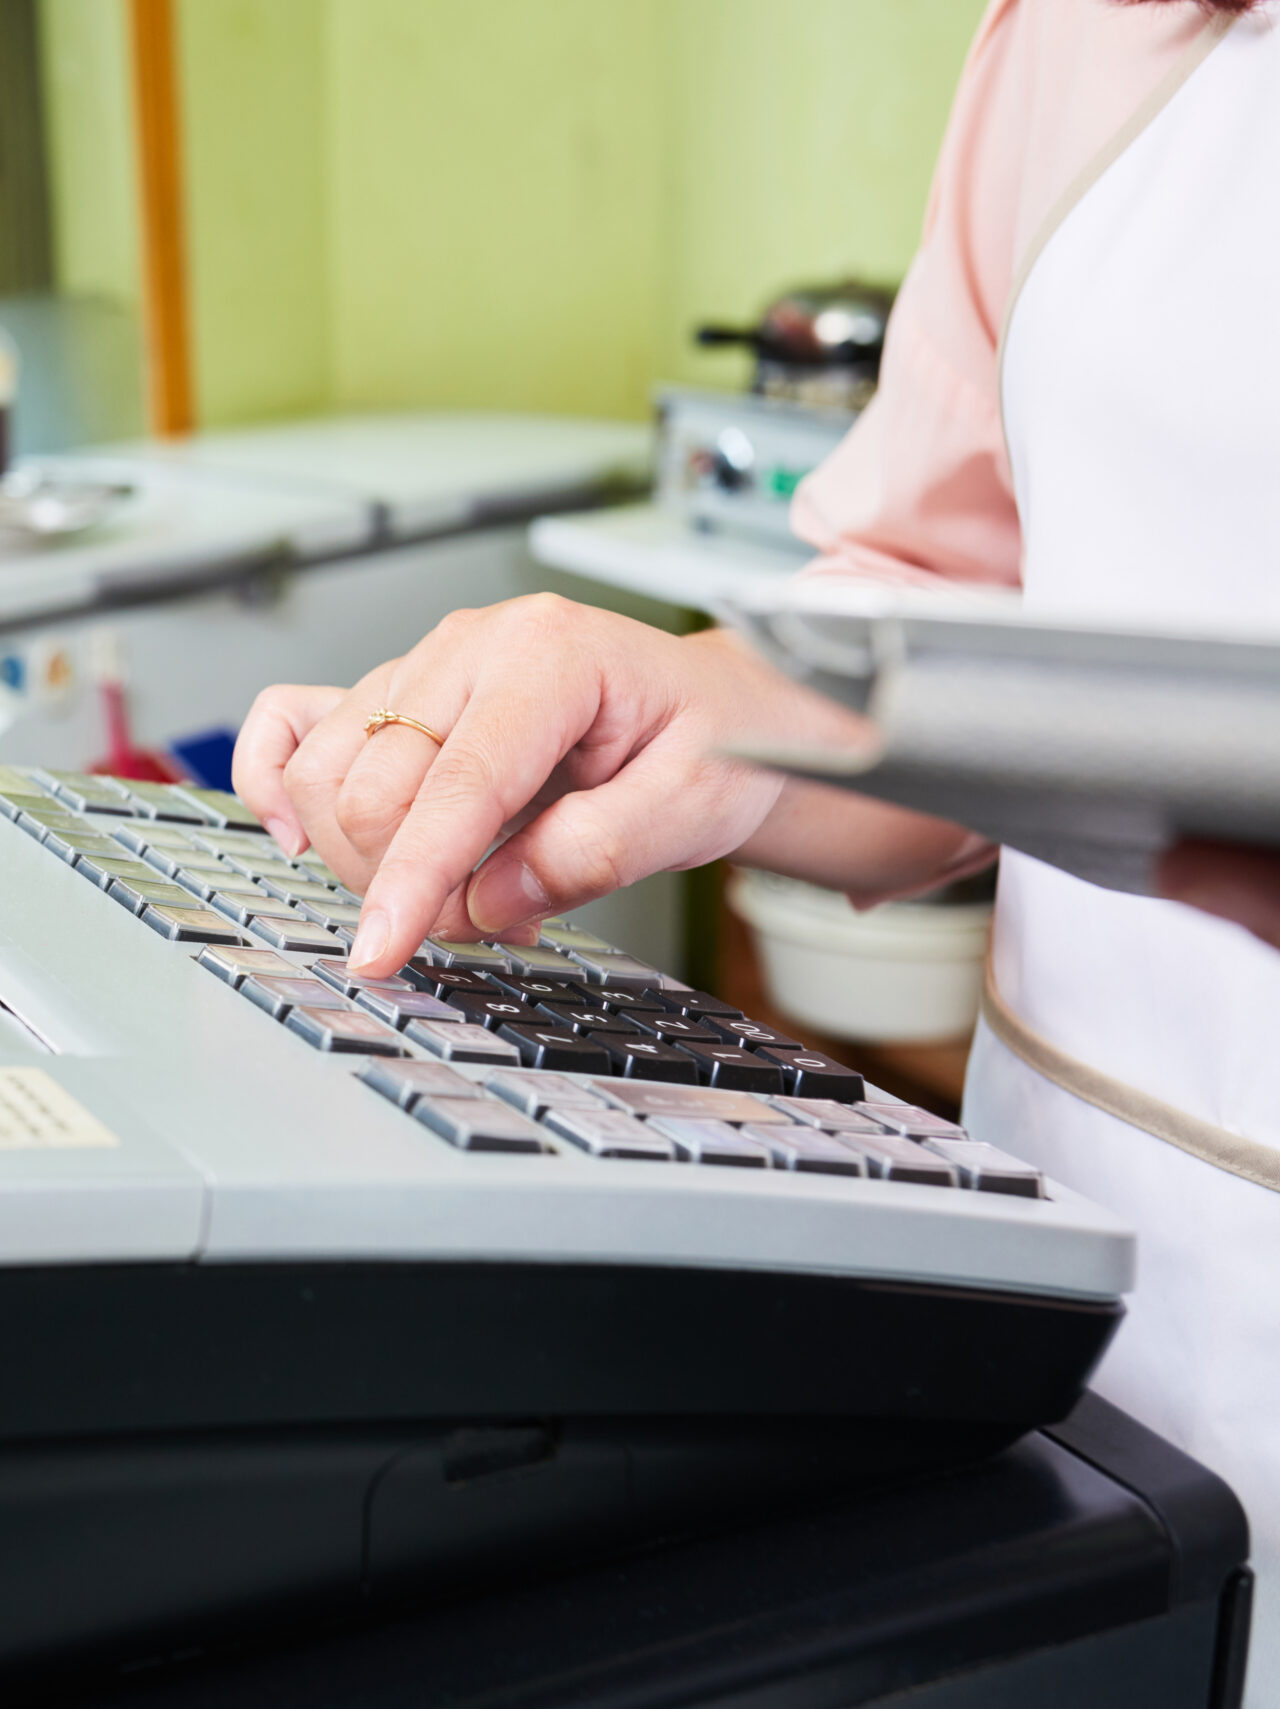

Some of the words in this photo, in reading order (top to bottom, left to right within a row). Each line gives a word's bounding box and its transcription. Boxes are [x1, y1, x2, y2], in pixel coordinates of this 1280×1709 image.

[439, 974, 472, 983] 9
[520, 982, 553, 992] 6
[601, 991, 635, 1001] 3
[486, 1003, 520, 1013] 8
[569, 1012, 608, 1022] 5
[654, 1020, 690, 1030] 2
[729, 1023, 775, 1040] 00
[535, 1033, 573, 1043] 7
[624, 1043, 658, 1054] 4
[793, 1058, 826, 1067] 0
